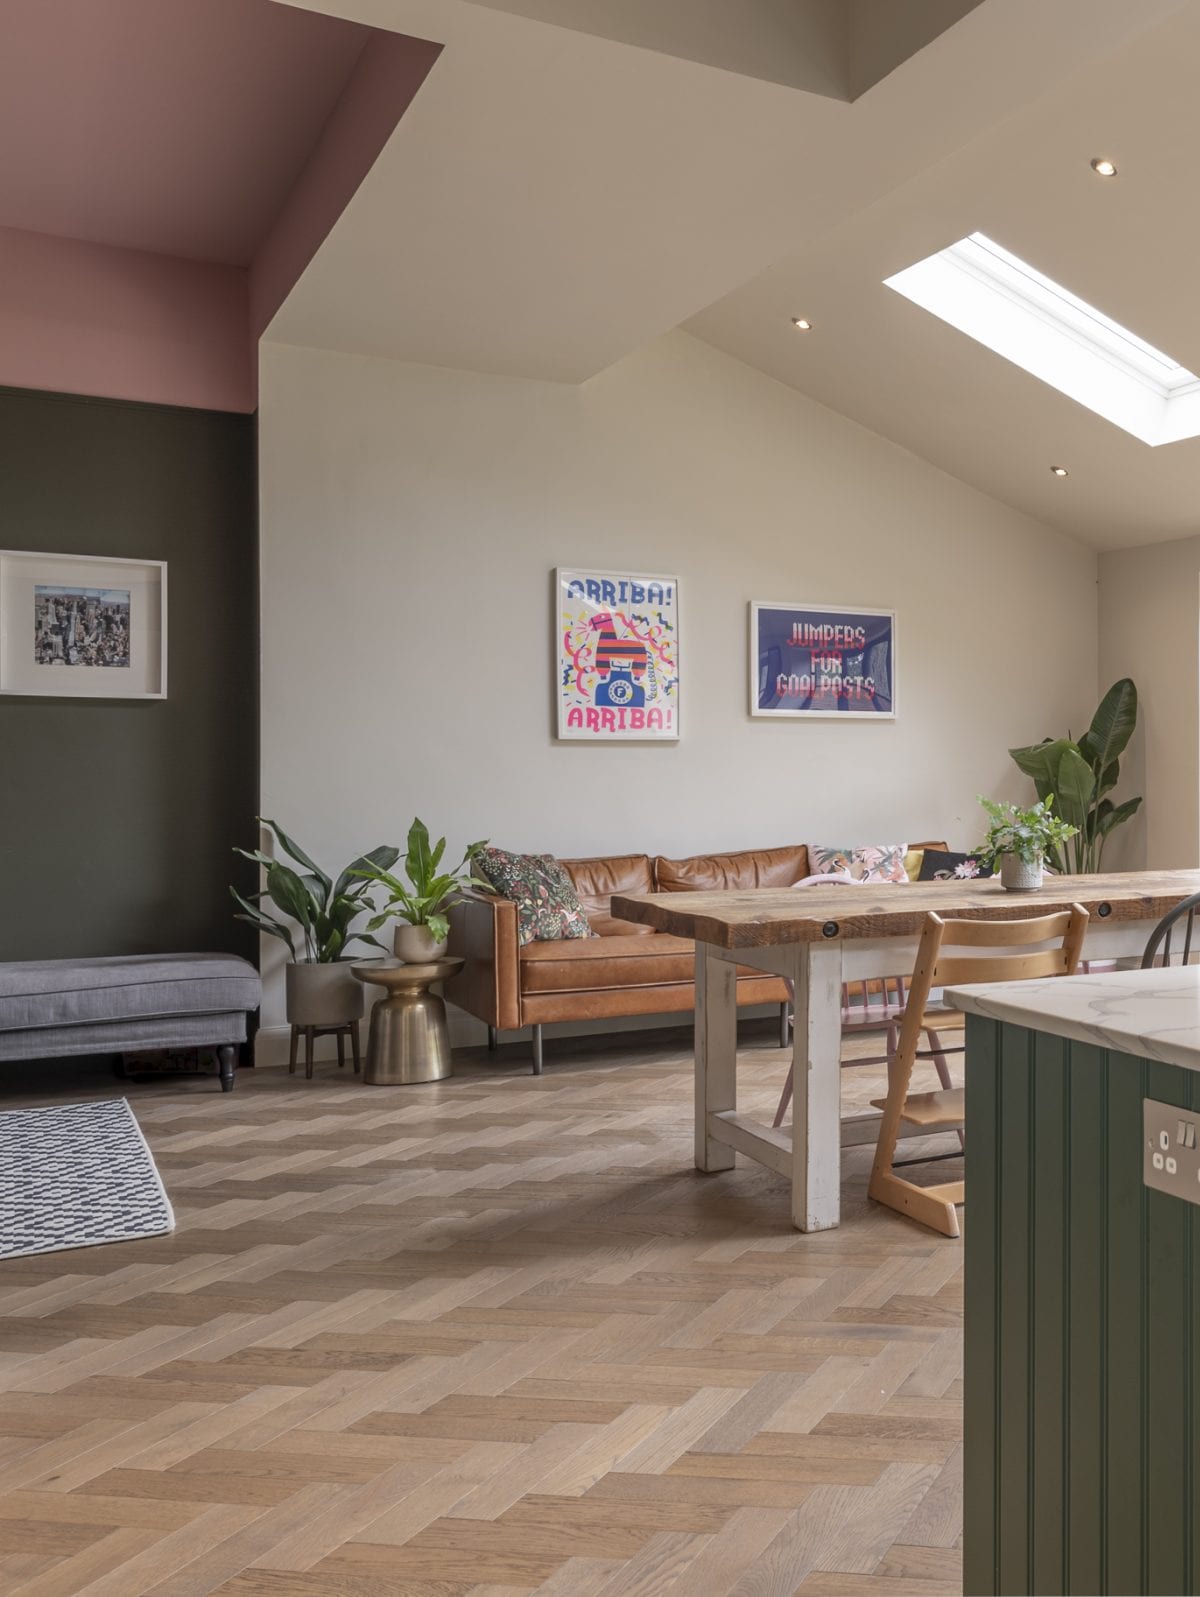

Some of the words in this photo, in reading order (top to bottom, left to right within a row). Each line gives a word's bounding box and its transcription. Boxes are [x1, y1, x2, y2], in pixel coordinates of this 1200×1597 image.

[567, 579, 672, 606] ARRIBA!
[787, 622, 865, 650] JUMPERS
[810, 649, 843, 674] FOR
[567, 707, 672, 733] ARRIBA!
